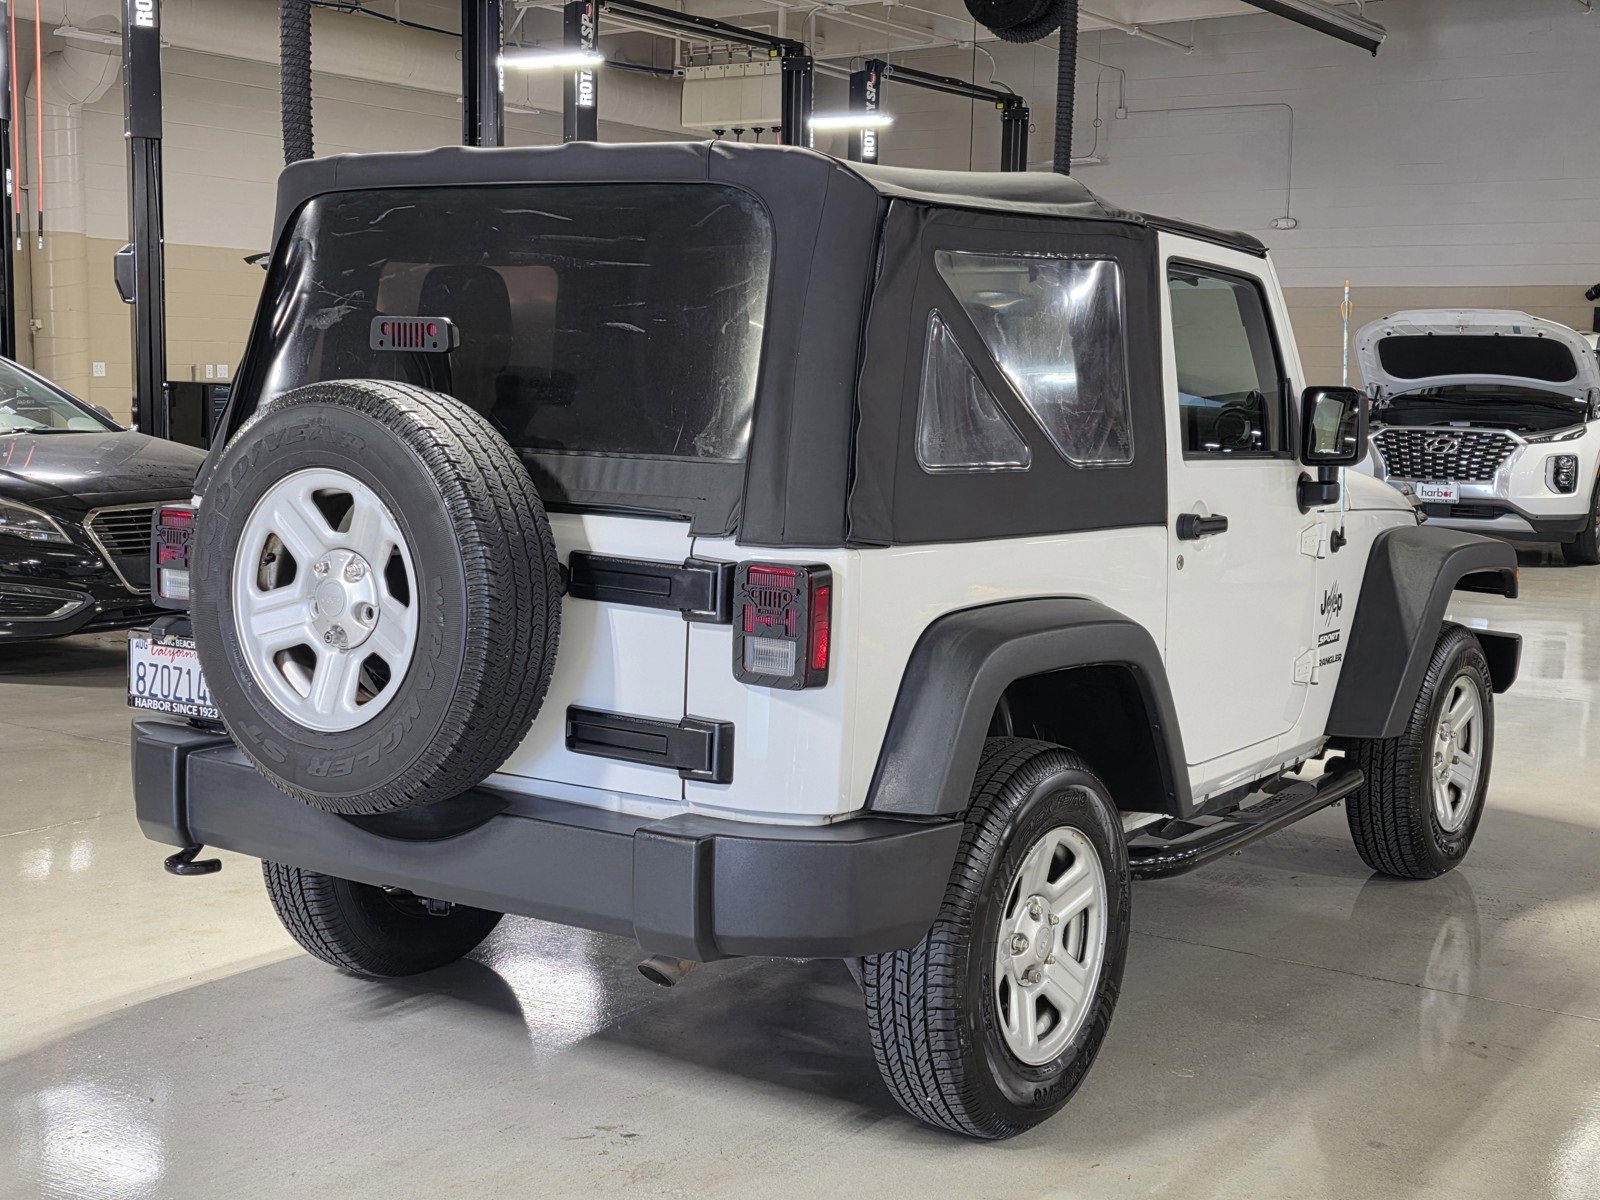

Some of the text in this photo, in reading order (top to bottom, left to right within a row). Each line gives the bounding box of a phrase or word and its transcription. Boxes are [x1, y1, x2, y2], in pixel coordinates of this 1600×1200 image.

[1421, 486, 1453, 497] harbor
[1320, 589, 1342, 617] Jeep
[135, 640, 148, 649] AUG
[175, 639, 196, 649] BEACH
[1318, 631, 1340, 646] SPORT
[1319, 653, 1342, 666] RANGLER
[135, 697, 218, 718] HARBOR SINCE 1923
